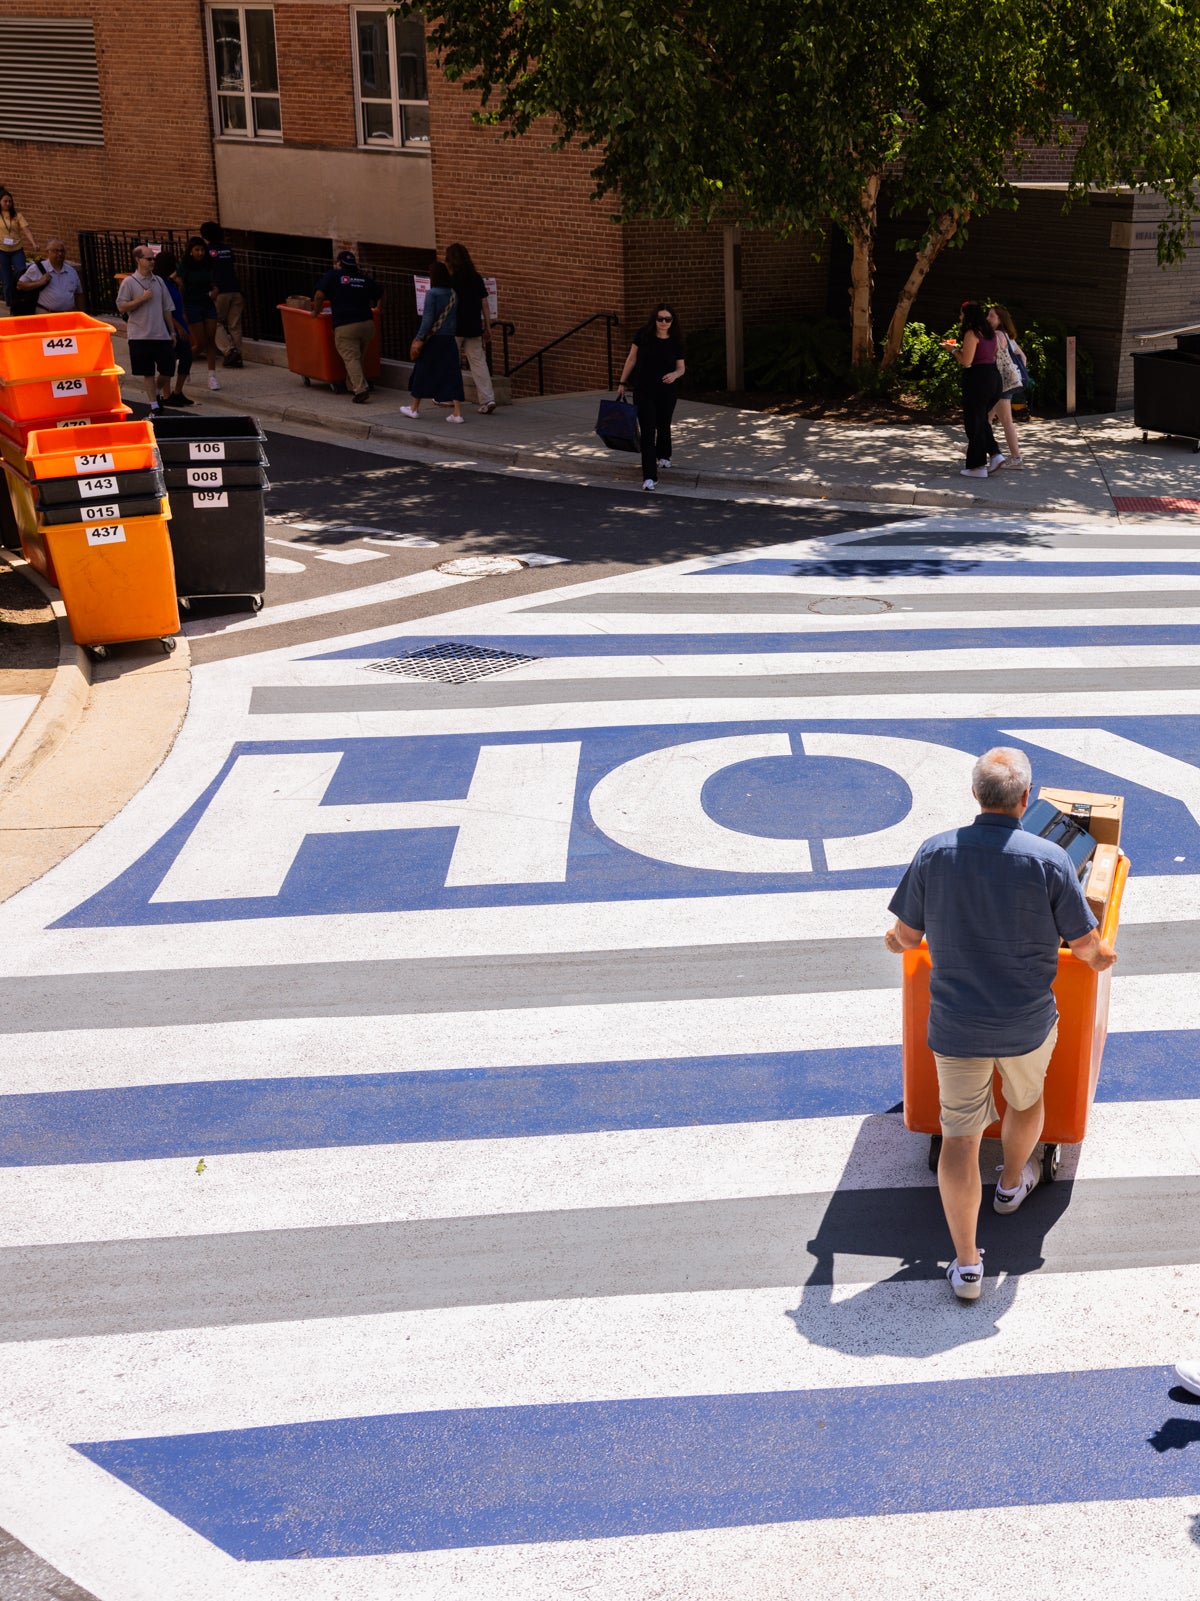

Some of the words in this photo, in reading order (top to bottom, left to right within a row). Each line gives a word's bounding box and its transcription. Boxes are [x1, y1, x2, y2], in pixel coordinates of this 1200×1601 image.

[46, 338, 73, 349] 442
[56, 379, 83, 391] 426
[194, 443, 221, 453] 106
[80, 453, 108, 466] 371
[192, 472, 218, 482] 008
[84, 478, 113, 491] 143
[197, 491, 224, 501] 097
[86, 506, 115, 519] 015
[91, 526, 119, 538] 437
